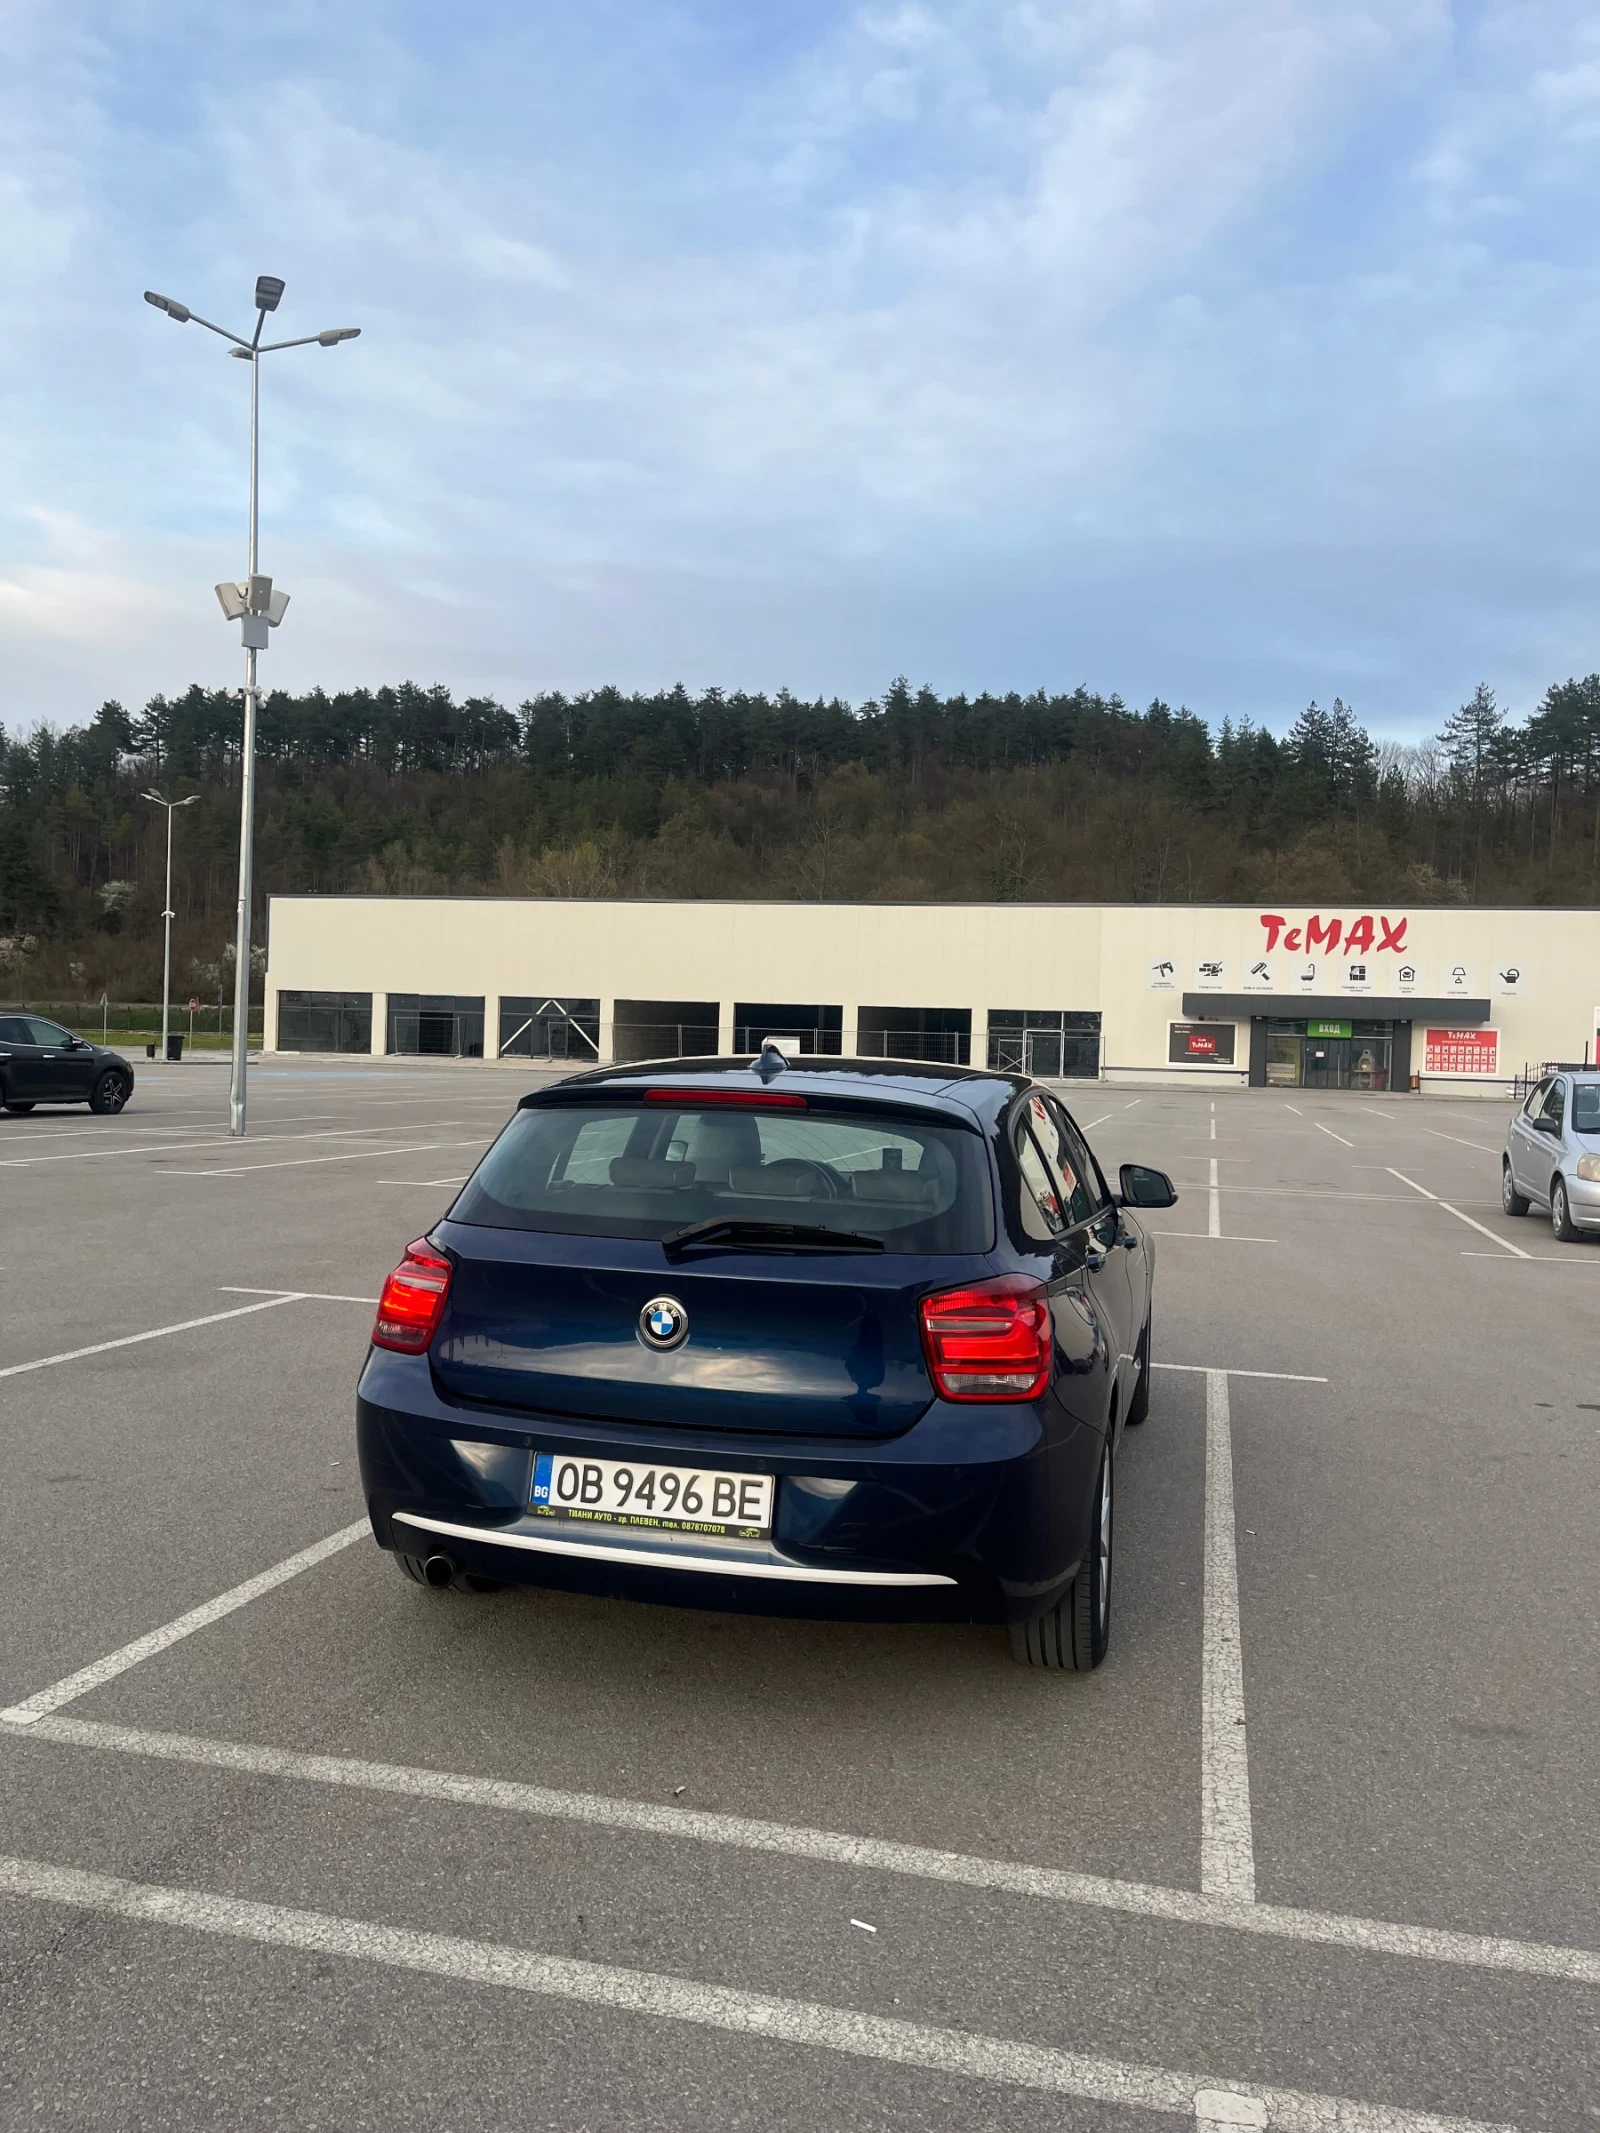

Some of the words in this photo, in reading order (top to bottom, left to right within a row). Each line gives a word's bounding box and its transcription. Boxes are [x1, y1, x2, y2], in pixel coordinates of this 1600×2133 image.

[1260, 914, 1408, 956] TeMAX
[1318, 1024, 1341, 1034] ВХОД
[1447, 1031, 1477, 1040] TeMAX
[647, 1302, 679, 1318] BMW
[534, 1485, 549, 1499] BG
[556, 1462, 604, 1504] OB
[612, 1467, 704, 1515] 9496
[711, 1476, 764, 1521] BE
[567, 1509, 593, 1520] ТИАНИ
[593, 1511, 613, 1522] АУТО
[629, 1516, 660, 1527] ПЛЕВЕН,
[681, 1522, 726, 1534] 0878707078
